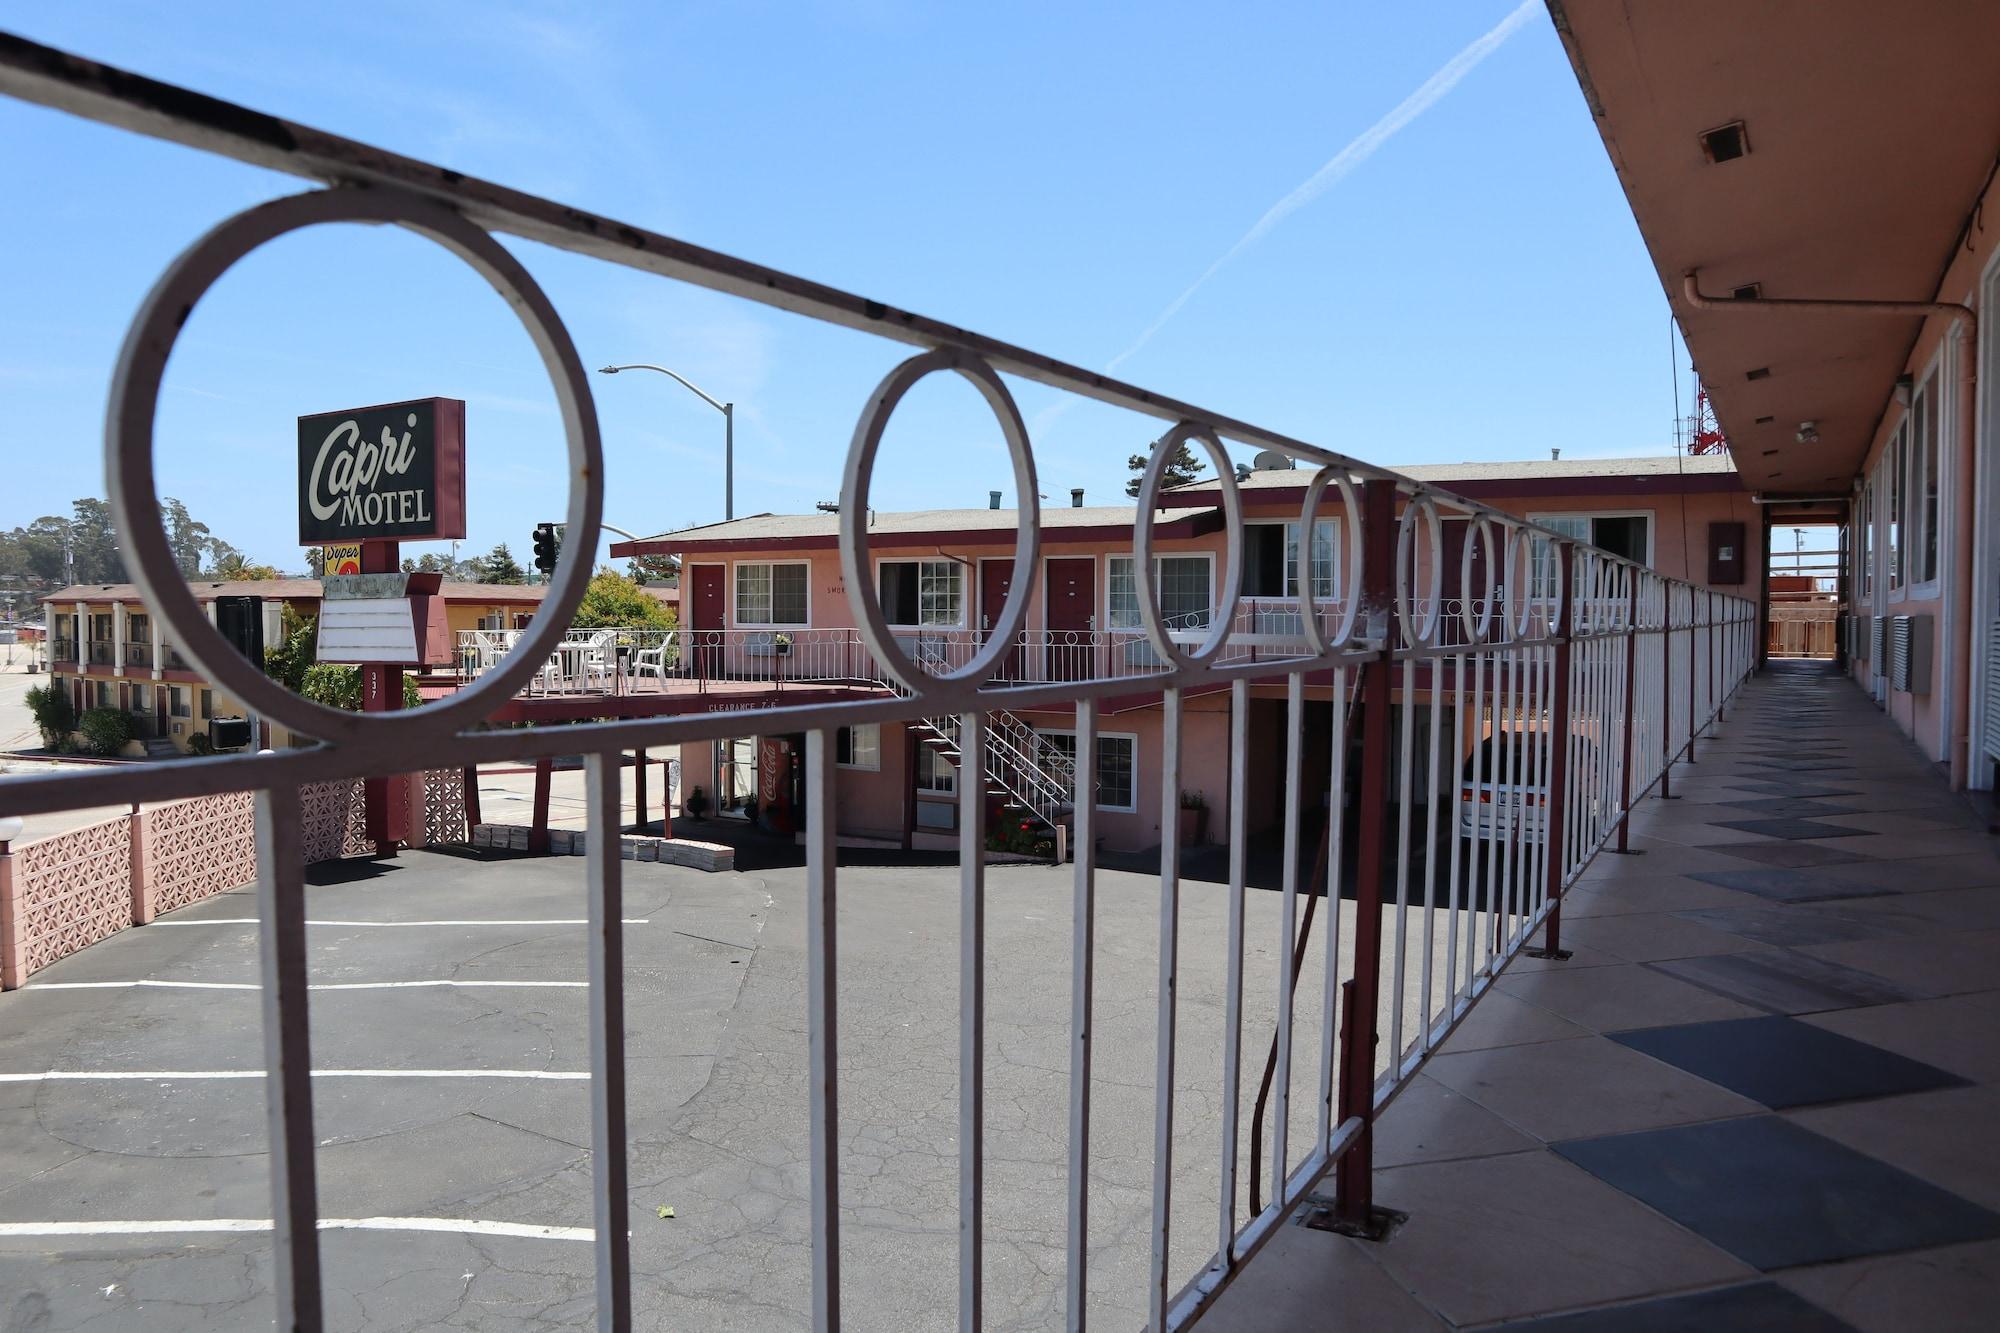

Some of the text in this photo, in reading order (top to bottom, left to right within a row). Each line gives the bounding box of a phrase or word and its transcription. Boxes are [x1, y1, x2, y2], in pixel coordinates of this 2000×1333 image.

[309, 413, 417, 520] Capri
[340, 490, 430, 526] MOTEL
[709, 703, 755, 712] CLEARANCE
